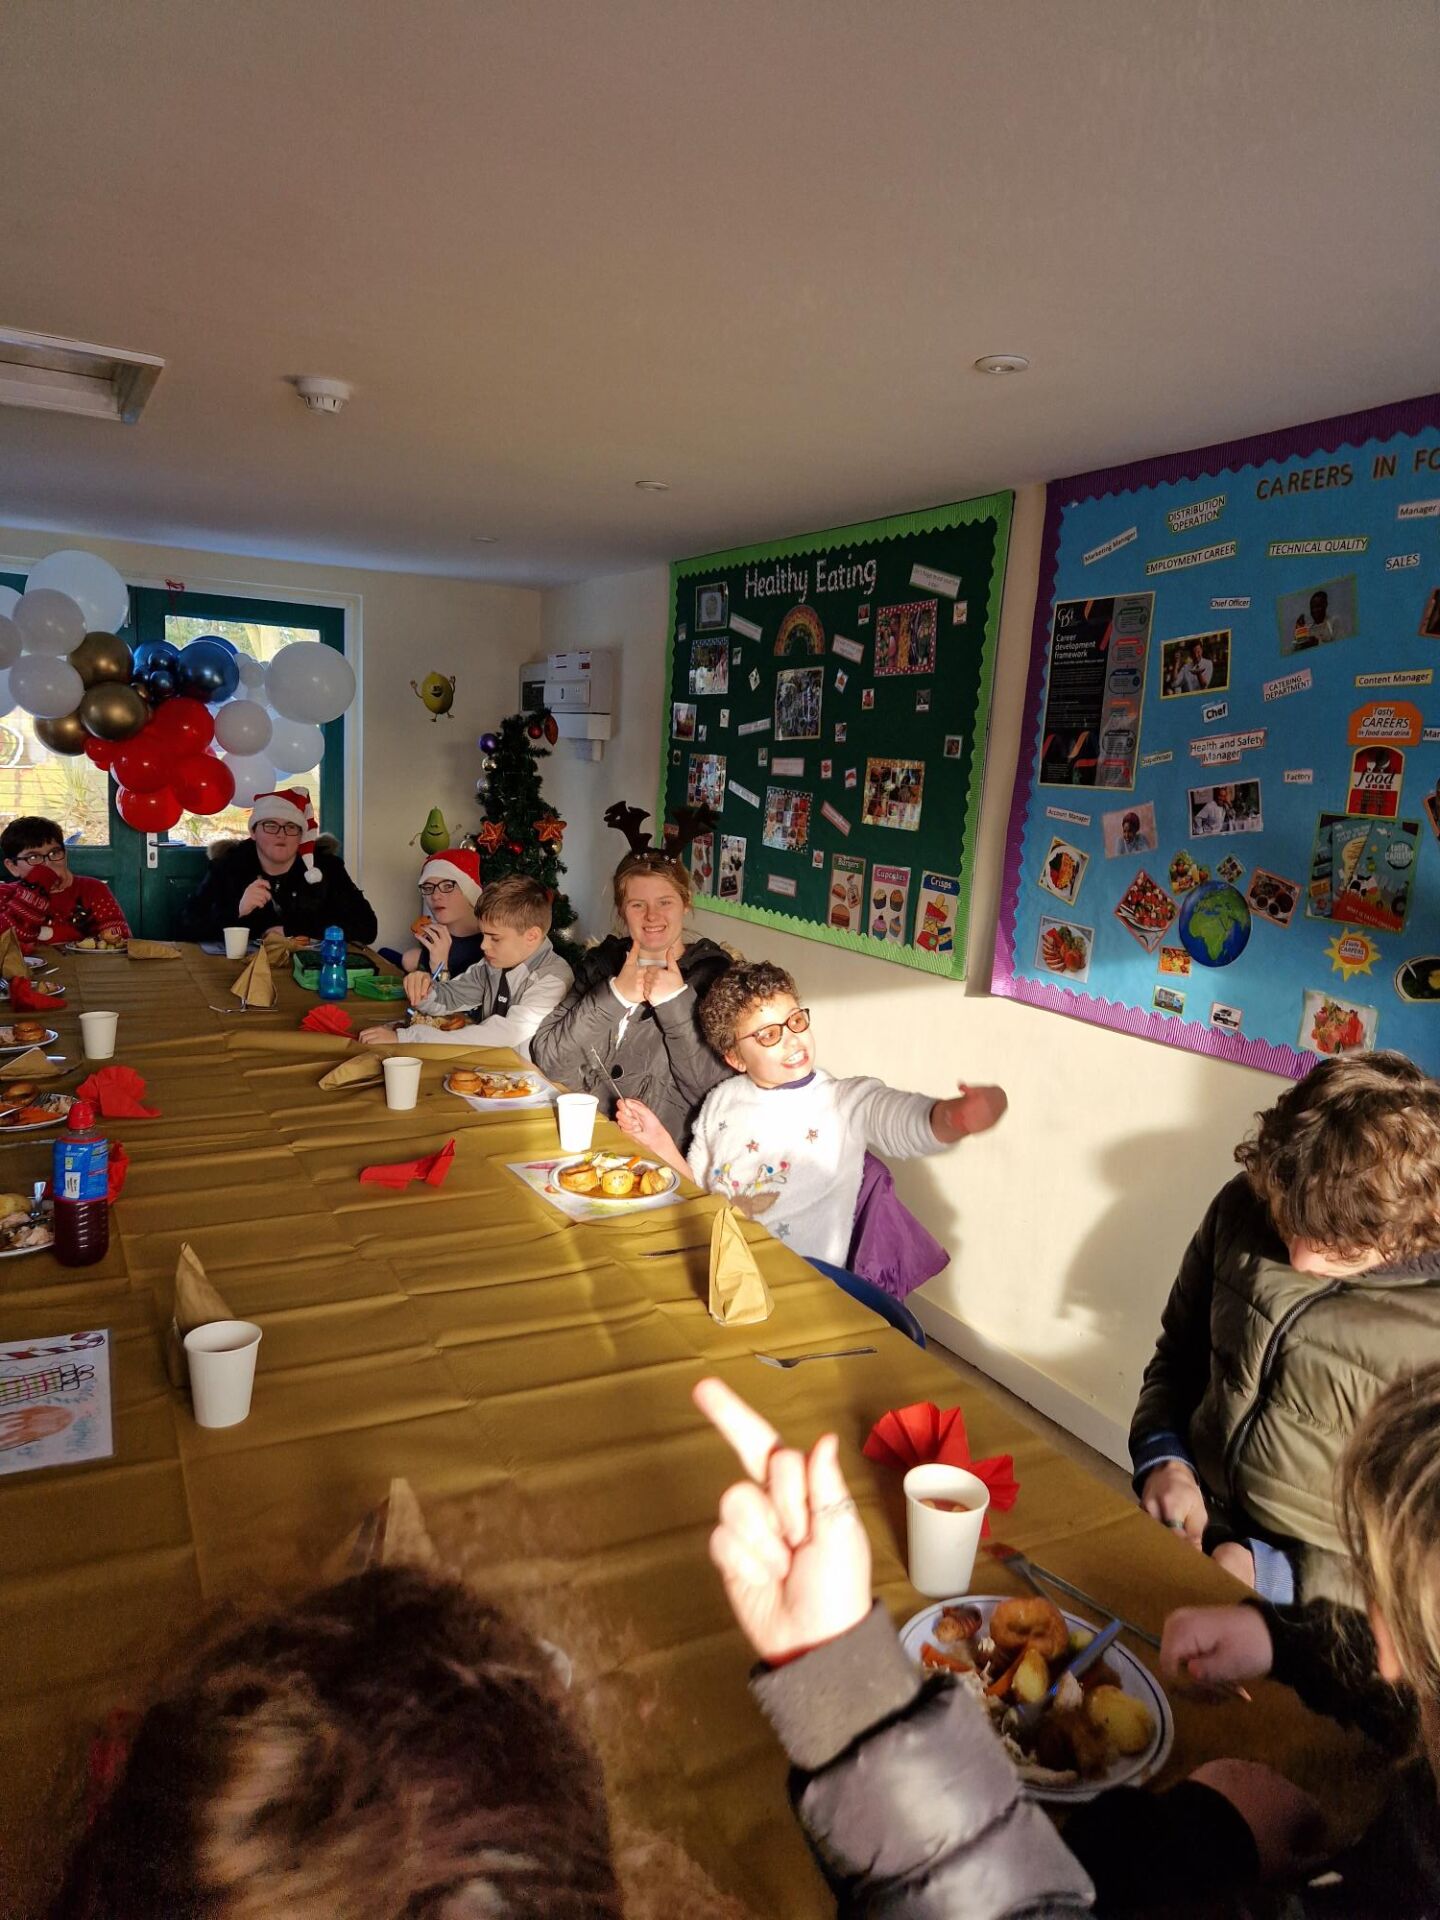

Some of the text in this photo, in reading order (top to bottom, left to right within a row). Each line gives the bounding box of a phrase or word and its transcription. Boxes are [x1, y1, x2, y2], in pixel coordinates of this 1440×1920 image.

[1257, 464, 1353, 499] CAREERS
[1373, 455, 1397, 479] IN
[1168, 497, 1225, 523] DISTRIBUTION
[1173, 510, 1219, 531] OPERATION
[1270, 539, 1368, 555] TECHNICAL QUALITY
[1146, 544, 1236, 574] EMPLOYMENT CAREER
[1386, 555, 1419, 570] SALES
[745, 562, 808, 603] Healthy
[815, 553, 877, 595] Eating
[1211, 599, 1227, 608] Chief
[1056, 634, 1077, 642] Career
[1055, 641, 1096, 651] development
[1054, 650, 1088, 659] framework
[1268, 676, 1302, 691] CATERING
[1359, 674, 1429, 685] Content Manager
[1265, 681, 1310, 700] DEPARTMENT
[1206, 705, 1227, 719] Chef
[1362, 717, 1409, 729] CAREERS
[1190, 735, 1265, 754] Health and Safety
[1203, 749, 1240, 763] Manager
[1354, 771, 1395, 787] food
[930, 876, 952, 890] Crisps
